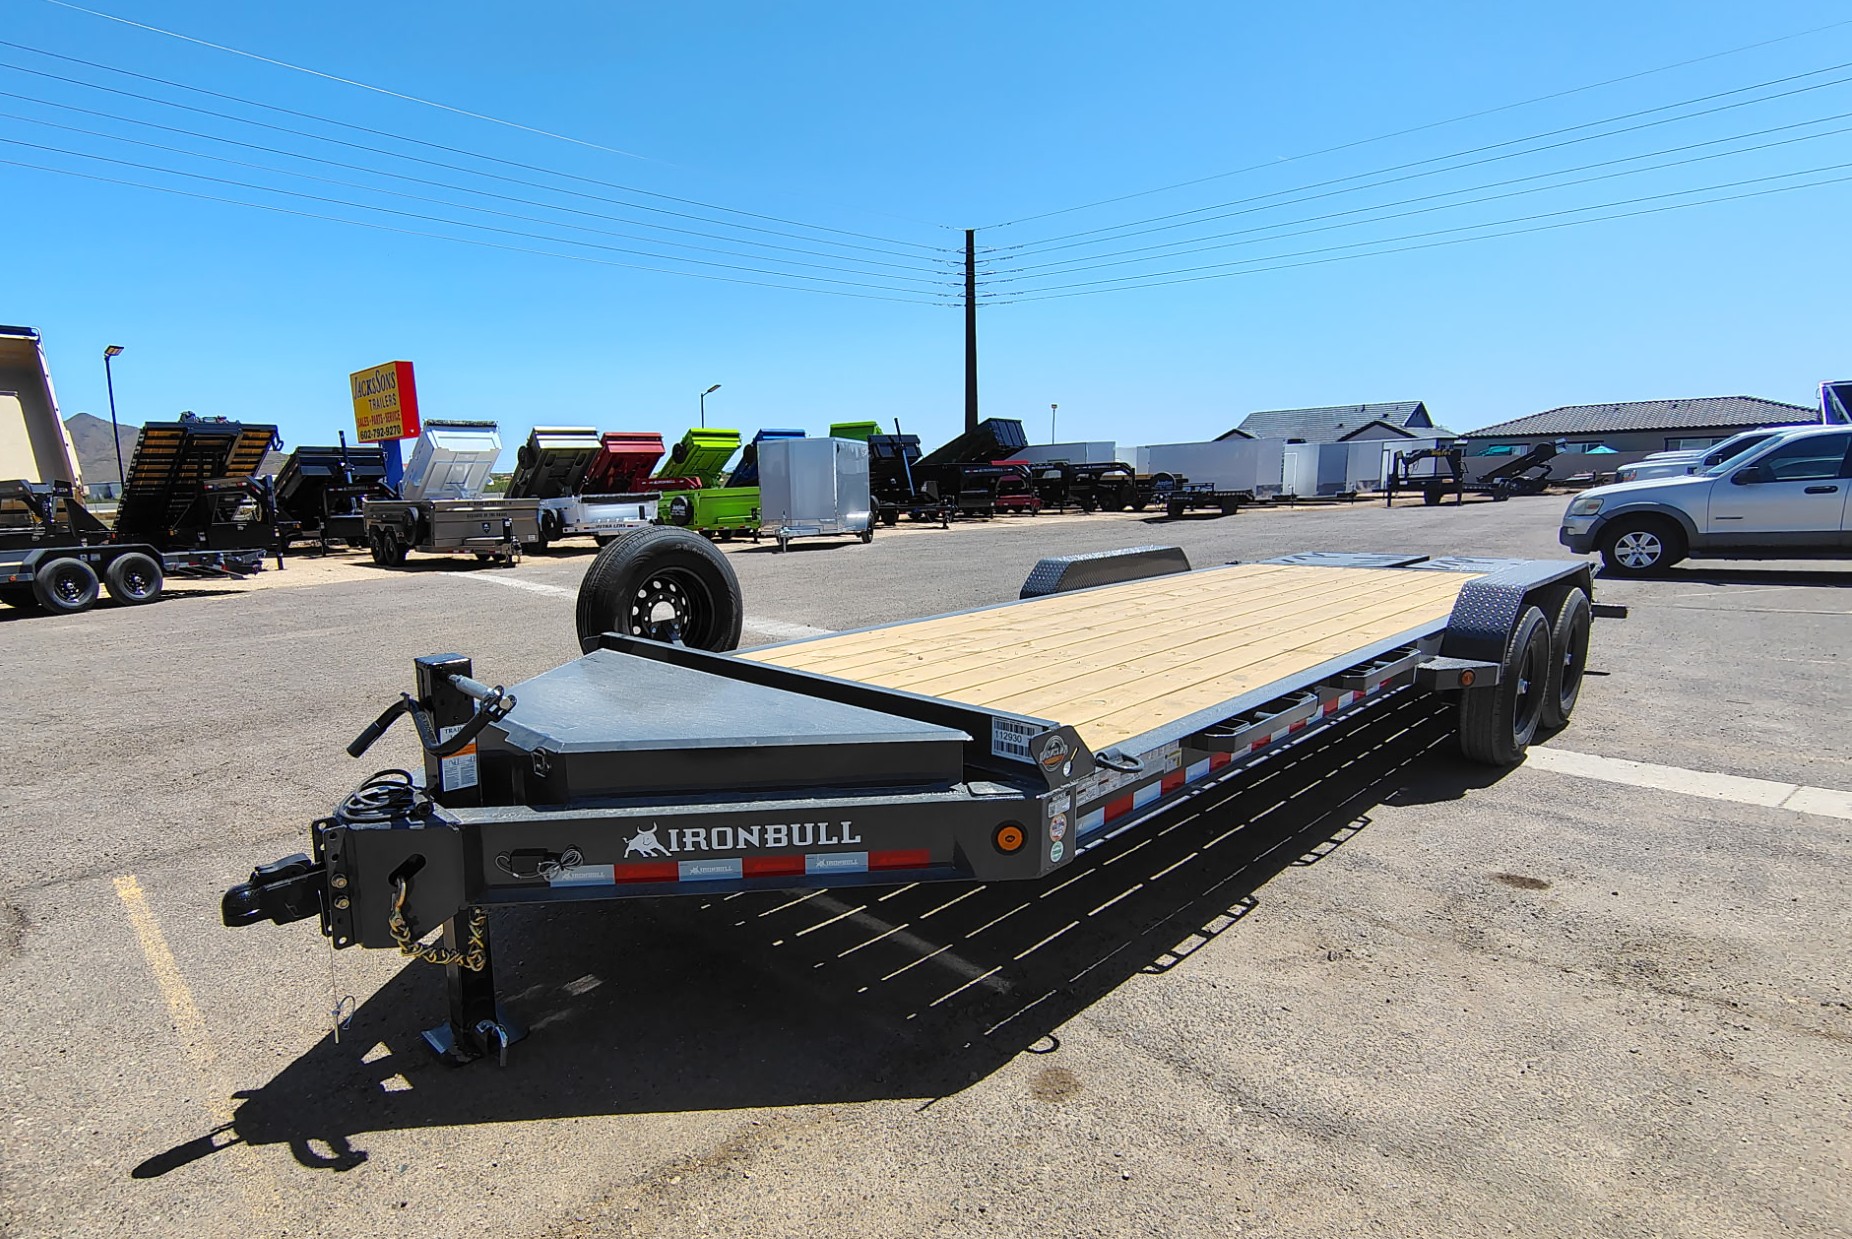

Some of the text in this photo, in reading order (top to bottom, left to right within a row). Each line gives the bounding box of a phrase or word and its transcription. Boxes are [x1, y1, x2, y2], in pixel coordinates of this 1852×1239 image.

[368, 393, 396, 411] TRAILERS
[360, 425, 402, 440] 602-792-9270
[995, 730, 1022, 743] 112930
[668, 821, 861, 852] IRONBULL
